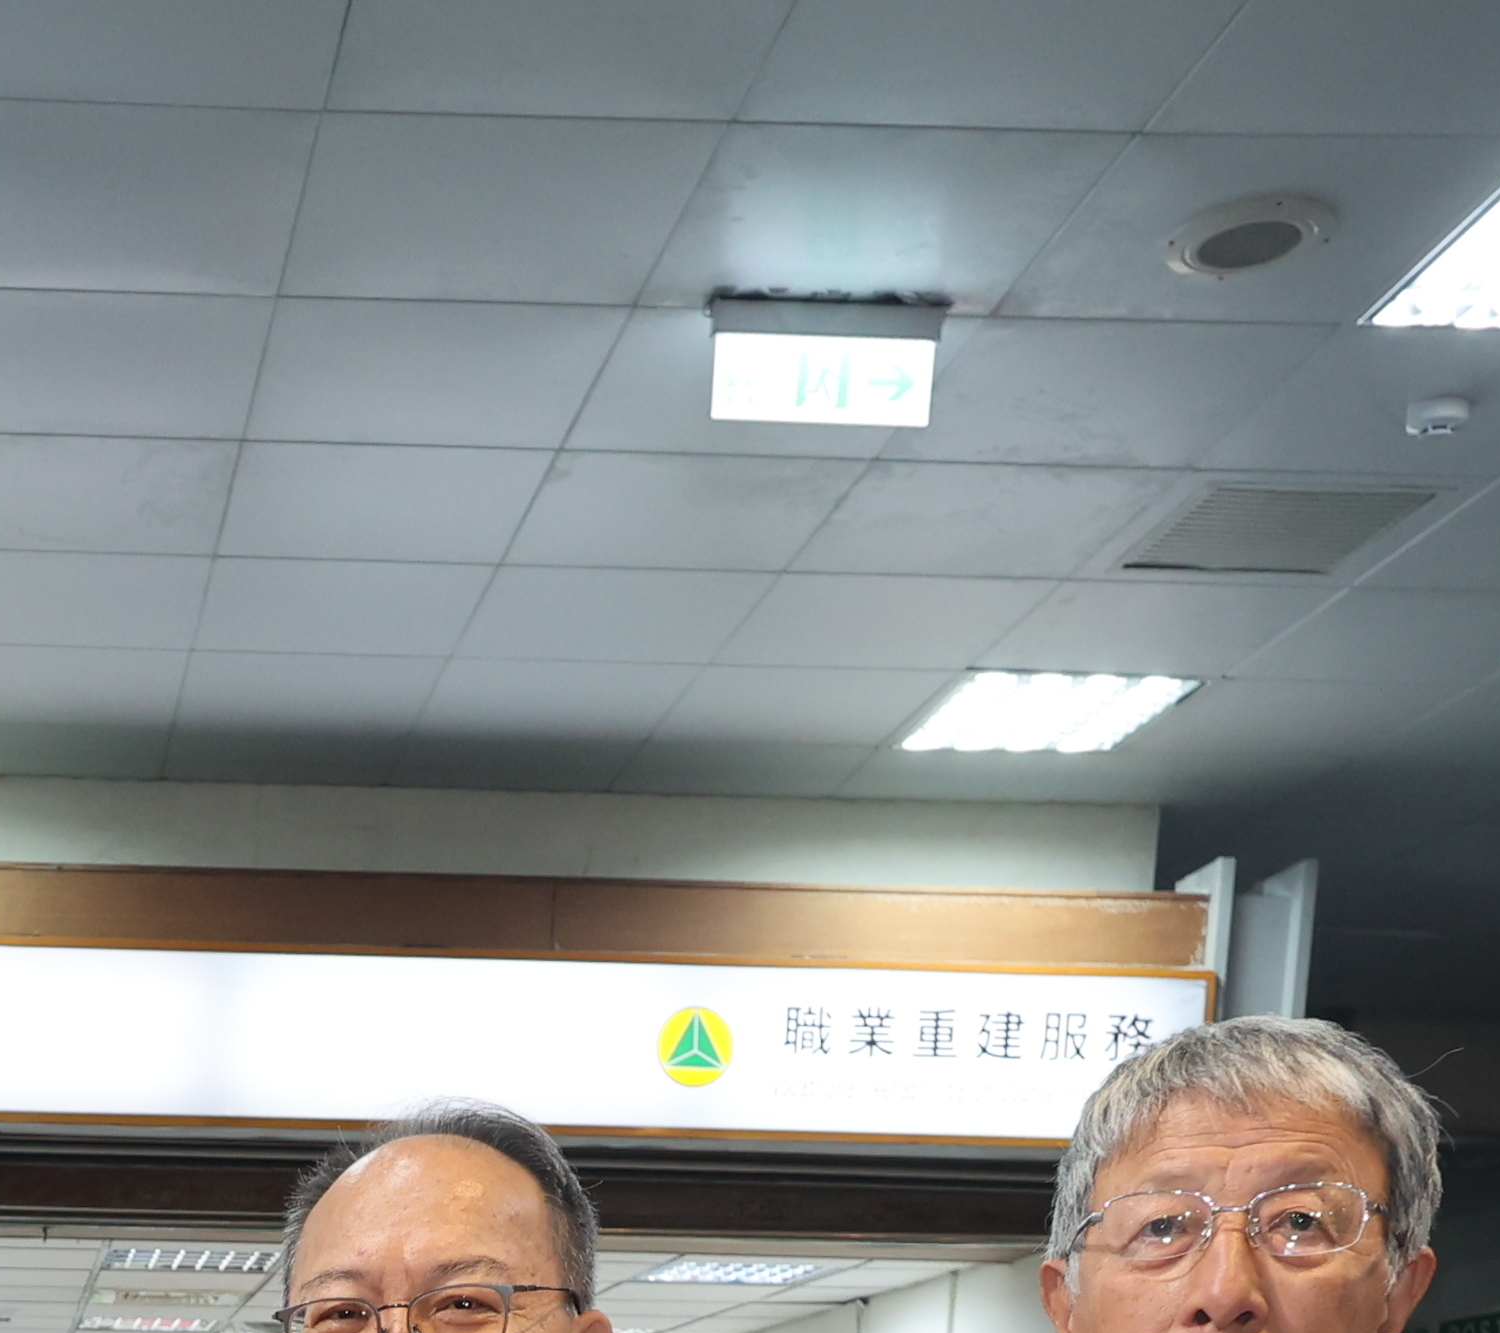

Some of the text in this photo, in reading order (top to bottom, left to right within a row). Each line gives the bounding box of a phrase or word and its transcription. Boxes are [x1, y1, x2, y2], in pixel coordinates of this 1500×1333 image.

[784, 1006, 1155, 1062] 職業重建服務
